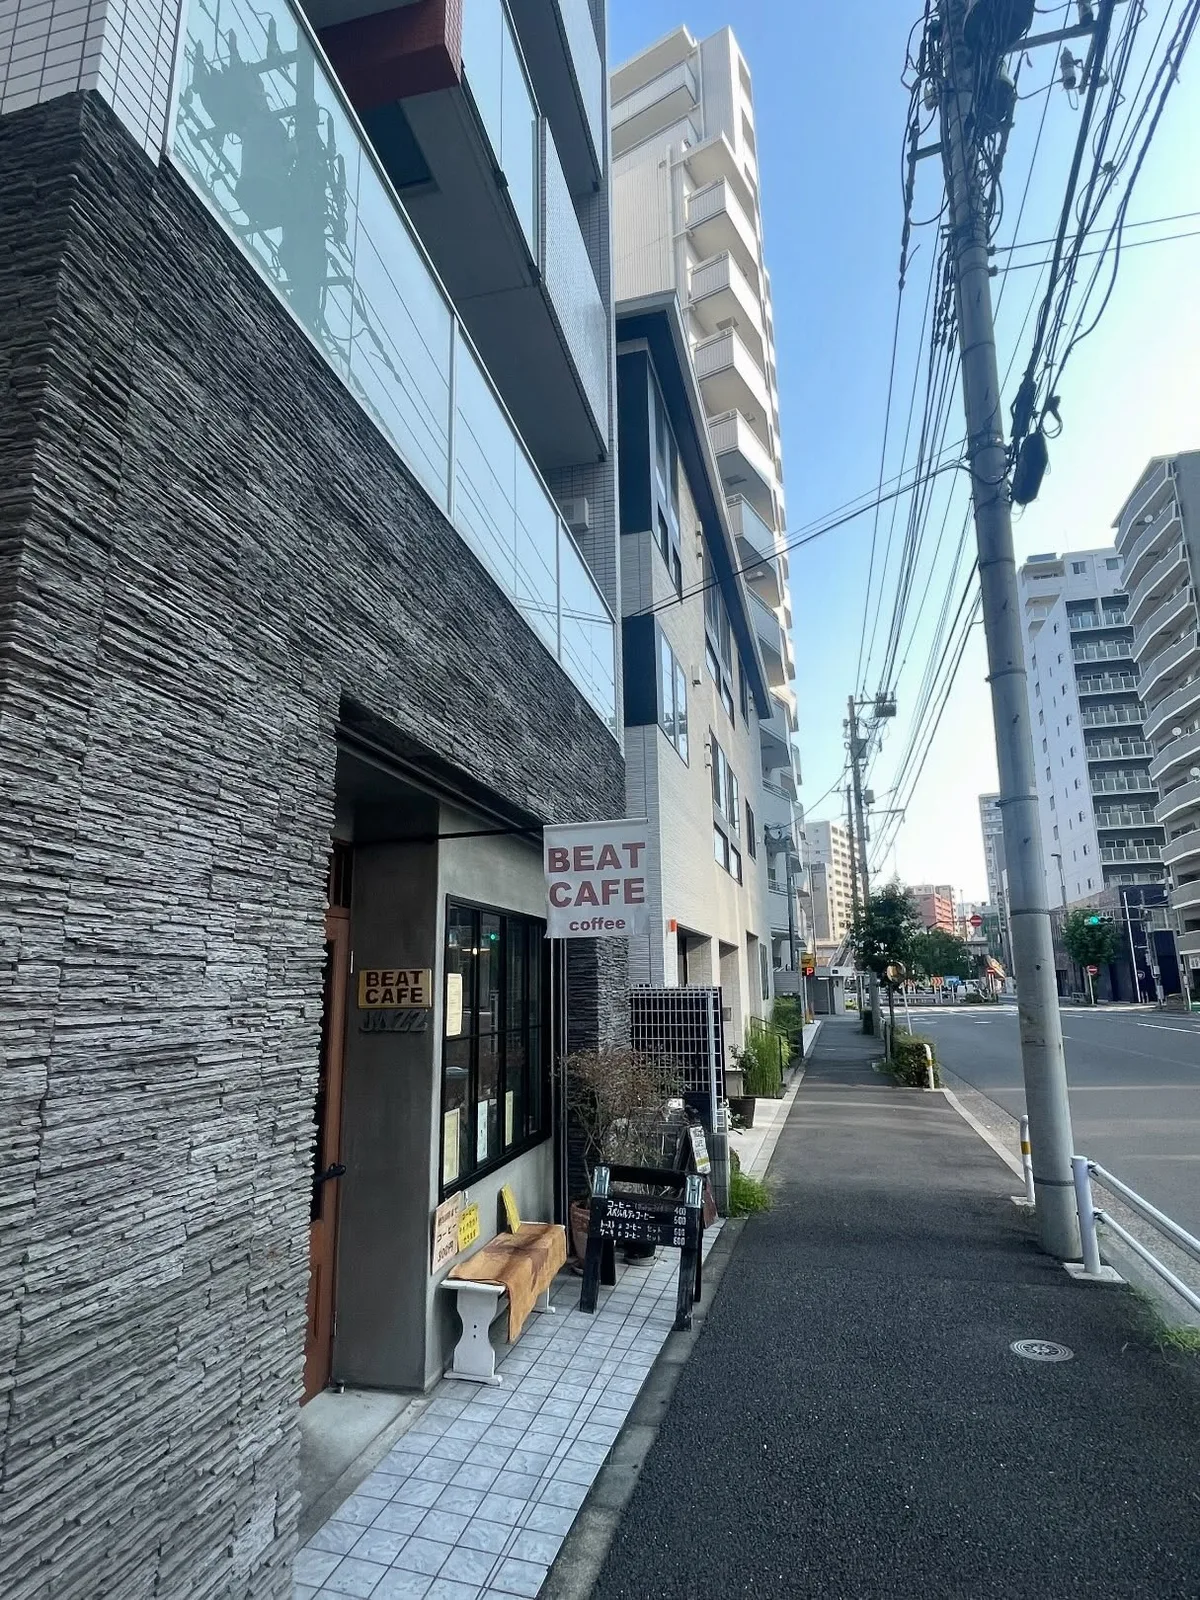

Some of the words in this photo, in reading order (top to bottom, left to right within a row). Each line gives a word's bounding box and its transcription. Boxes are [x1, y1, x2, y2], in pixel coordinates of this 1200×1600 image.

[547, 842, 646, 873] BEAT
[549, 878, 645, 908] CAFE
[569, 917, 626, 931] coffee
[366, 970, 423, 987] BEAT
[806, 967, 814, 976] P
[365, 988, 423, 1004] CAFE
[607, 1200, 631, 1209] コーヒー
